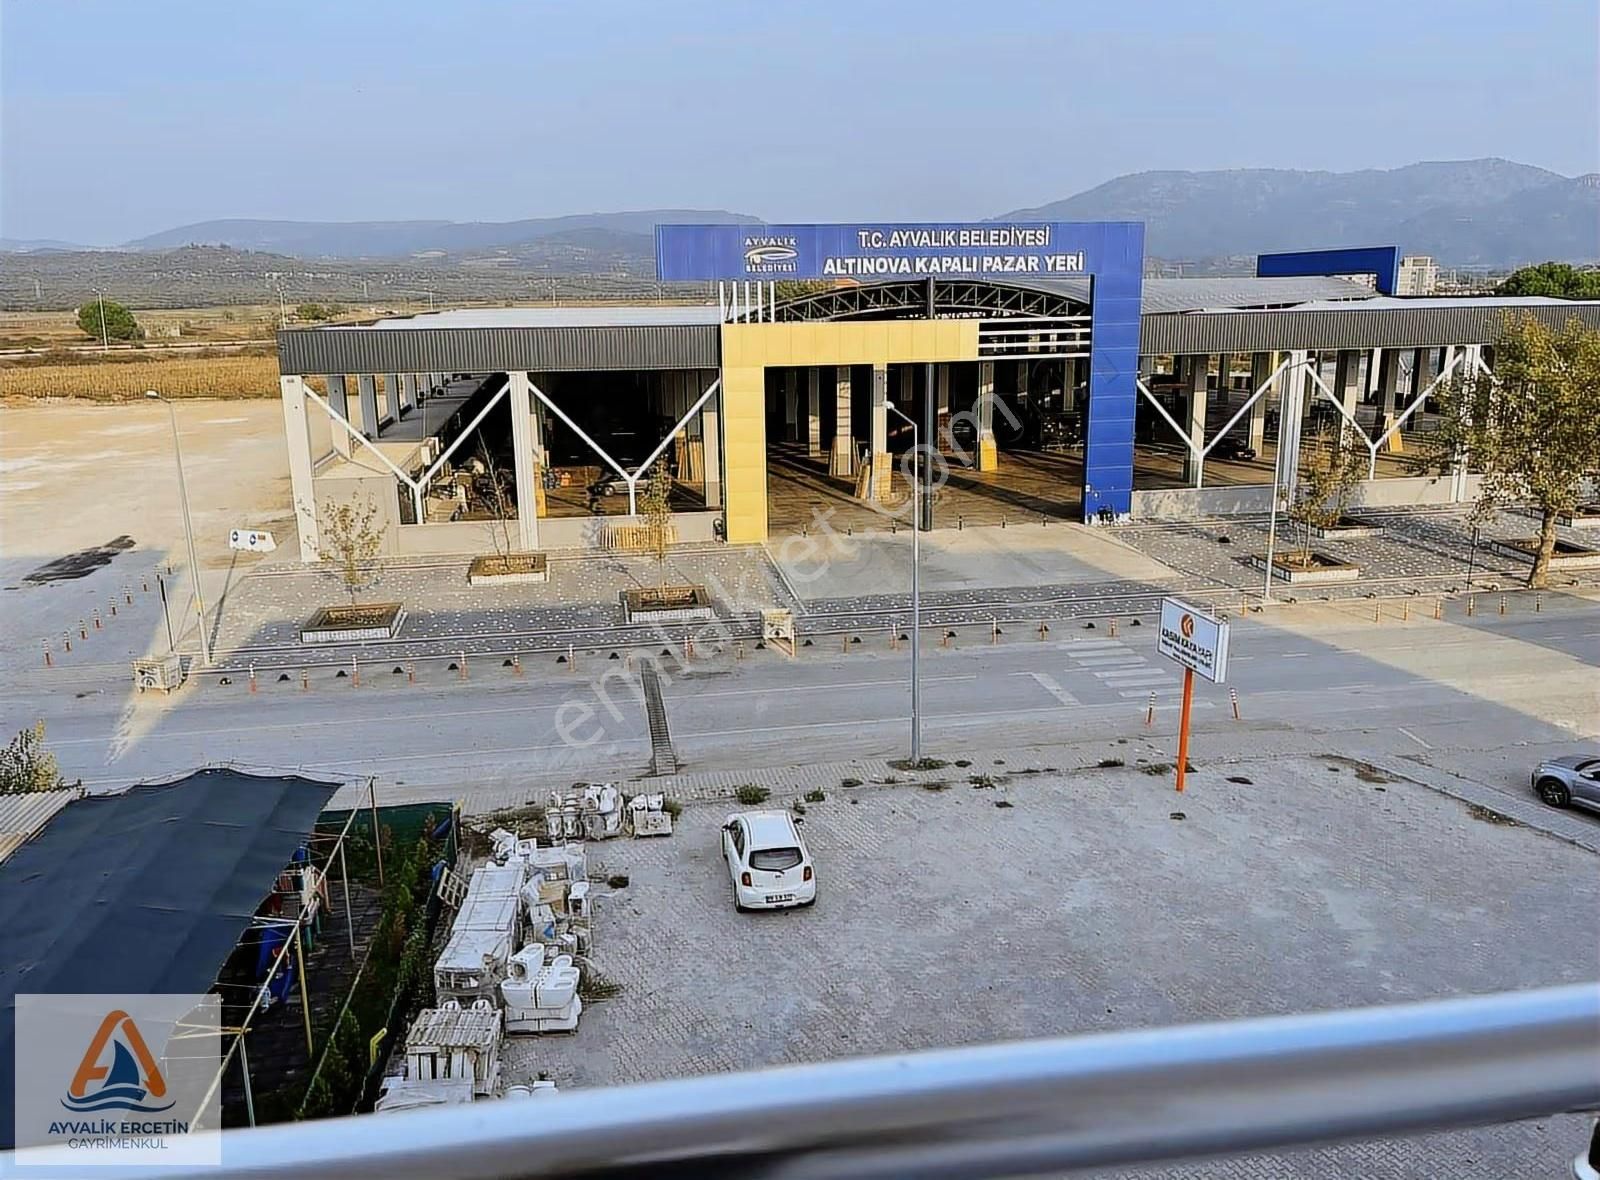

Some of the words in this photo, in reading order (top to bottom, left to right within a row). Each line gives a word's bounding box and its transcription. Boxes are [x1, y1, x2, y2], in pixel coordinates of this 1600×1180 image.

[745, 237, 797, 247] AYVALIK
[859, 230, 887, 247] T.C.
[890, 230, 956, 247] AYVALIK
[958, 226, 1050, 247] BELEDİYESİ
[823, 257, 913, 275] ALTINOVA
[915, 256, 977, 274] KAPALI
[981, 255, 1040, 273] PAZAR
[1045, 252, 1084, 271] YERİ
